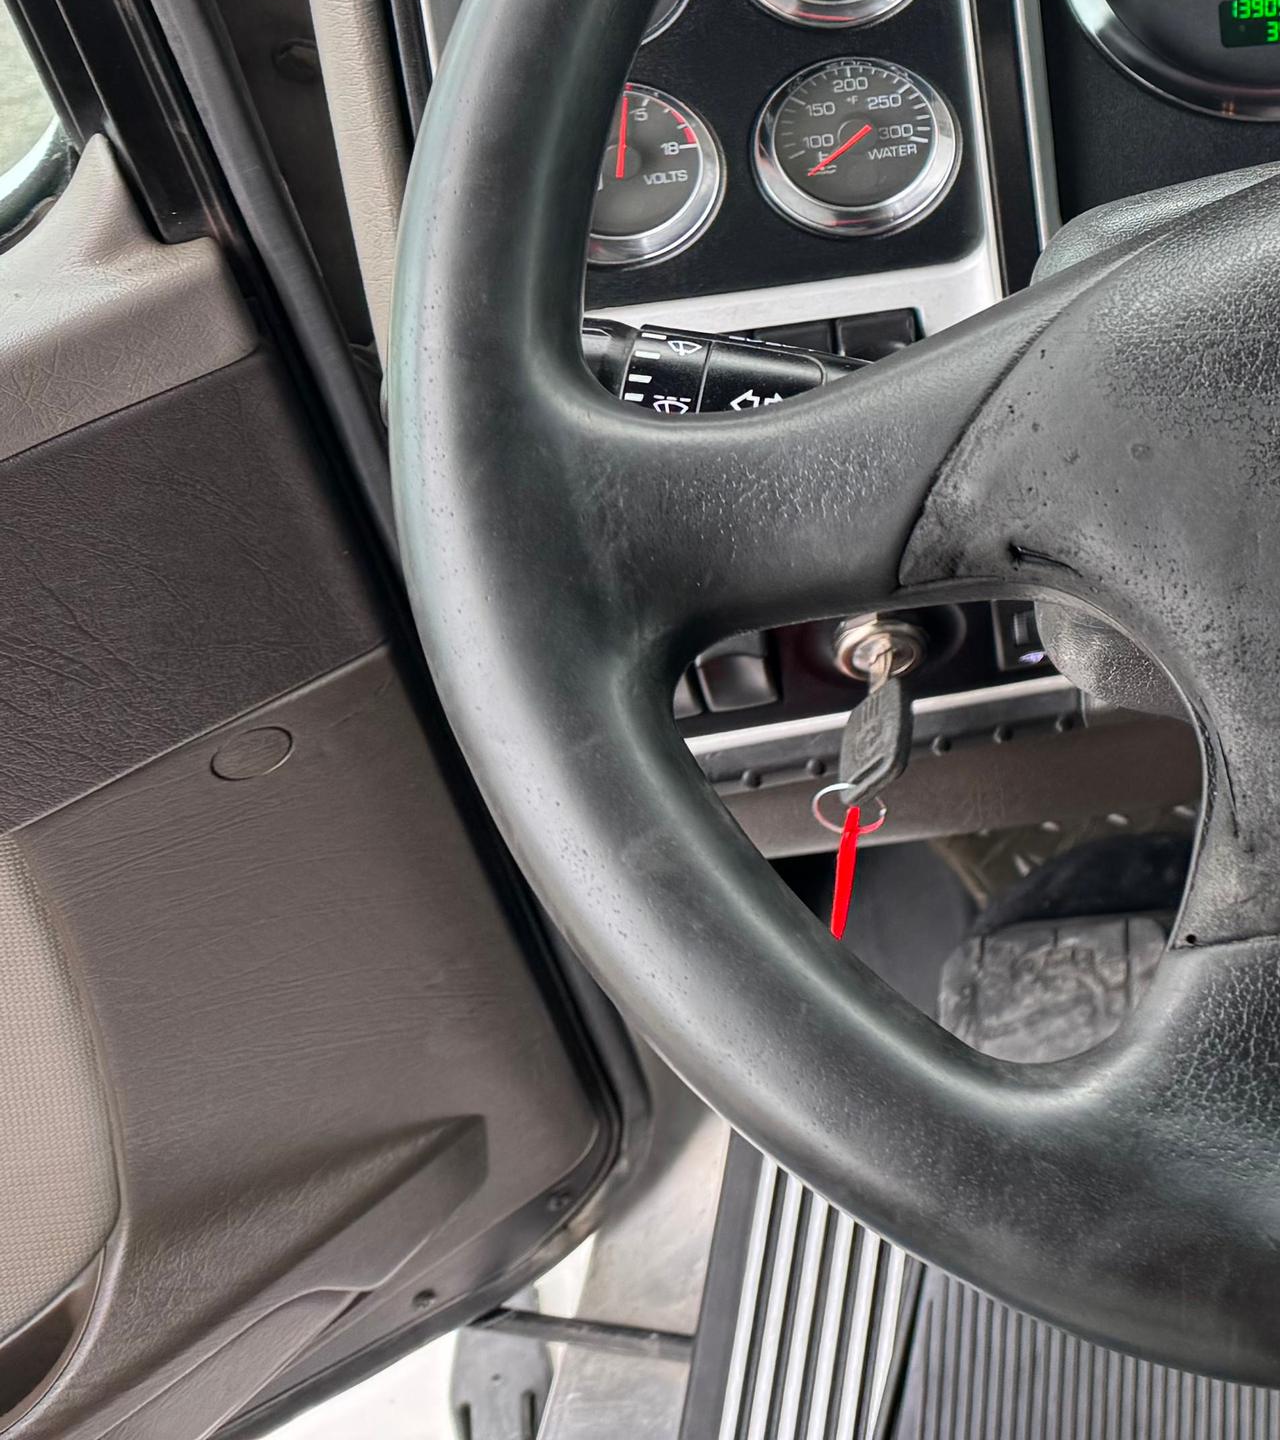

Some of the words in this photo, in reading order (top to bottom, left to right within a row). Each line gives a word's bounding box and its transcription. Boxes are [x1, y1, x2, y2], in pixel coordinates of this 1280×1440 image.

[832, 76, 869, 93] 200
[805, 101, 836, 117] 150
[867, 93, 902, 110] 250
[878, 124, 914, 140] 300
[660, 141, 680, 156] 18
[803, 133, 834, 149] 100
[867, 143, 918, 161] WATER
[643, 169, 689, 186] VOLTS
